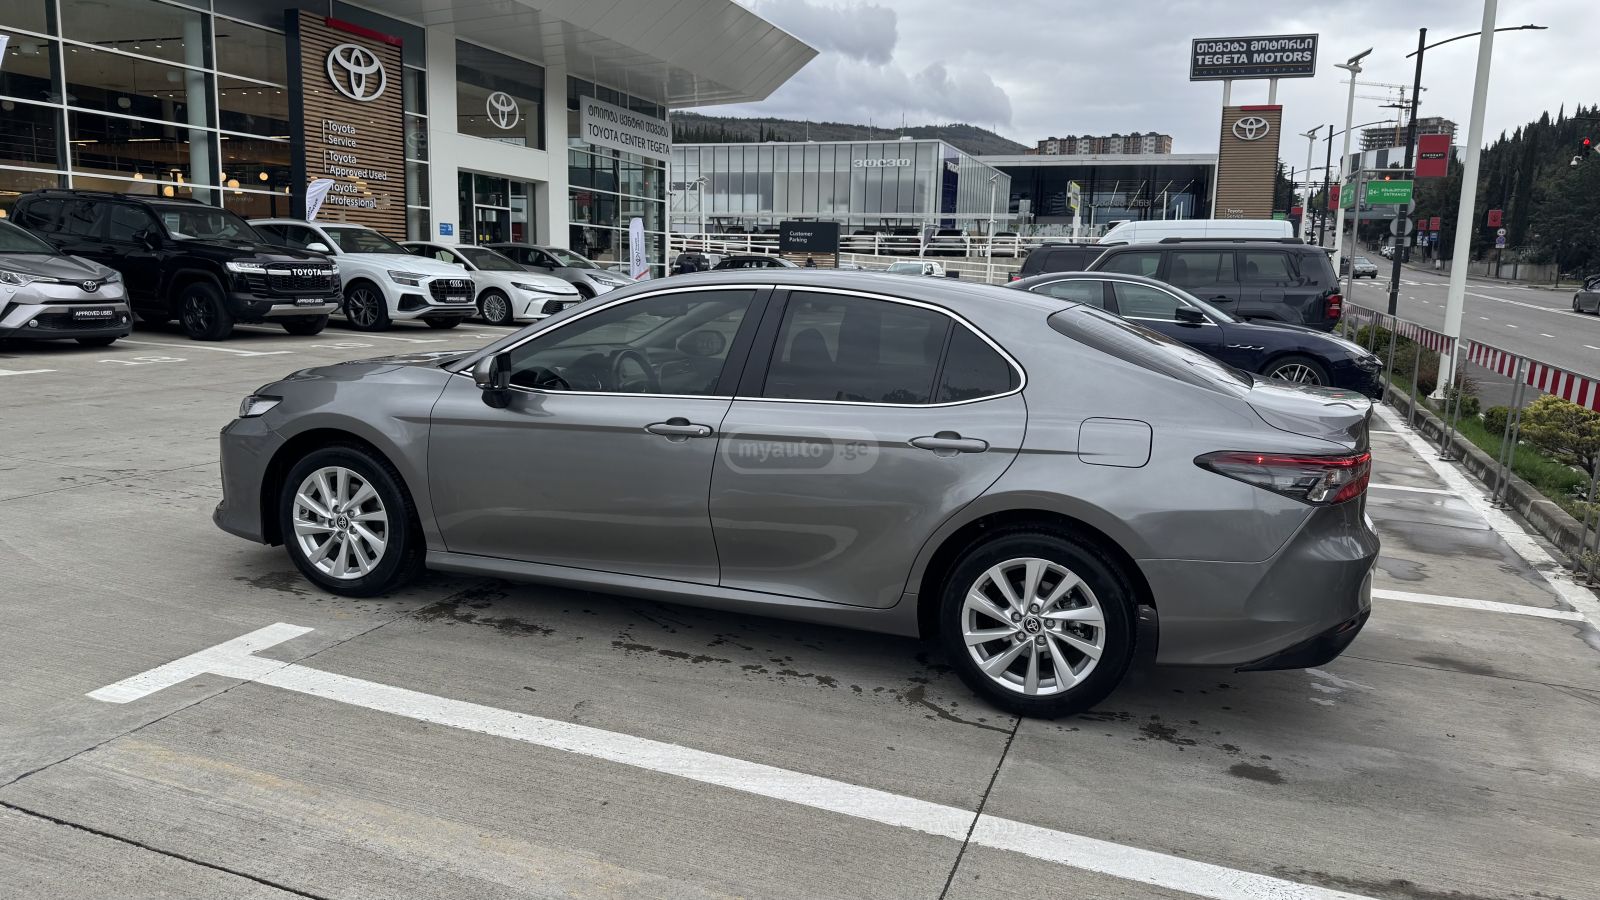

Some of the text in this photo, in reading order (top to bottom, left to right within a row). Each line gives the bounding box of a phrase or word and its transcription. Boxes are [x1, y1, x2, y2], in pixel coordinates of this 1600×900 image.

[1196, 38, 1313, 53] თეგეტა მოტორსი
[1196, 51, 1312, 65] TEGETA MOTORS
[328, 120, 356, 134] Toyota
[588, 105, 669, 138] ტოიოტა ცენტრი თეგეტა
[328, 134, 357, 147] Service
[588, 123, 670, 155] TOYOTA CENTER TEGETA
[329, 150, 357, 164] Toyota
[329, 165, 387, 180] Approved Used
[331, 182, 358, 194] Toyota
[330, 195, 377, 208] Professional
[292, 268, 322, 276] TOYOTA
